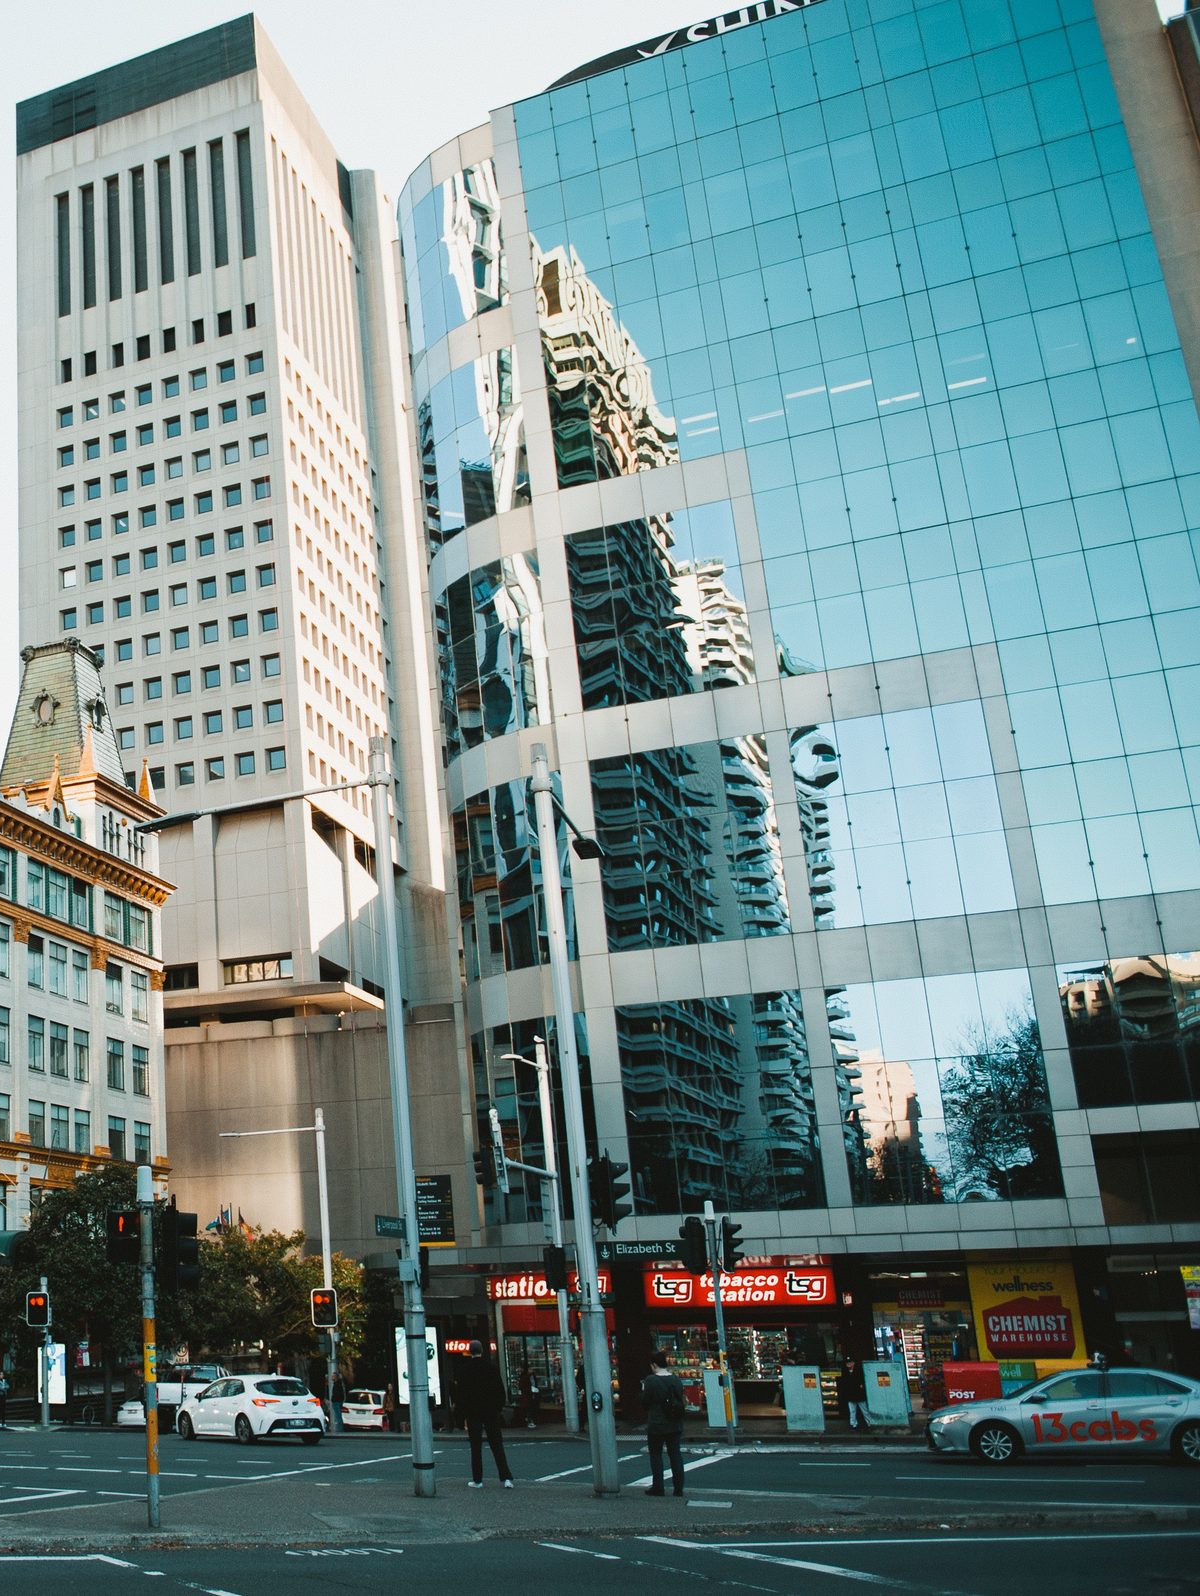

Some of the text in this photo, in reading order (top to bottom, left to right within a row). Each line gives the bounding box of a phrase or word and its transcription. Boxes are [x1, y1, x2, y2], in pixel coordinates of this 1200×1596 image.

[616, 1242, 676, 1255] Elizabeth St
[495, 1276, 557, 1298] statio
[652, 1274, 692, 1303] tsg
[699, 1273, 779, 1288] tobacco
[784, 1271, 827, 1301] tsg
[992, 1275, 1054, 1293] wellness
[706, 1287, 776, 1302] station
[987, 1314, 1068, 1332] CHEMIST
[990, 1333, 1068, 1342] WAREHOUSE
[1000, 1364, 1021, 1377] well
[949, 1391, 975, 1399] POST
[1030, 1411, 1158, 1444] 13cabs
